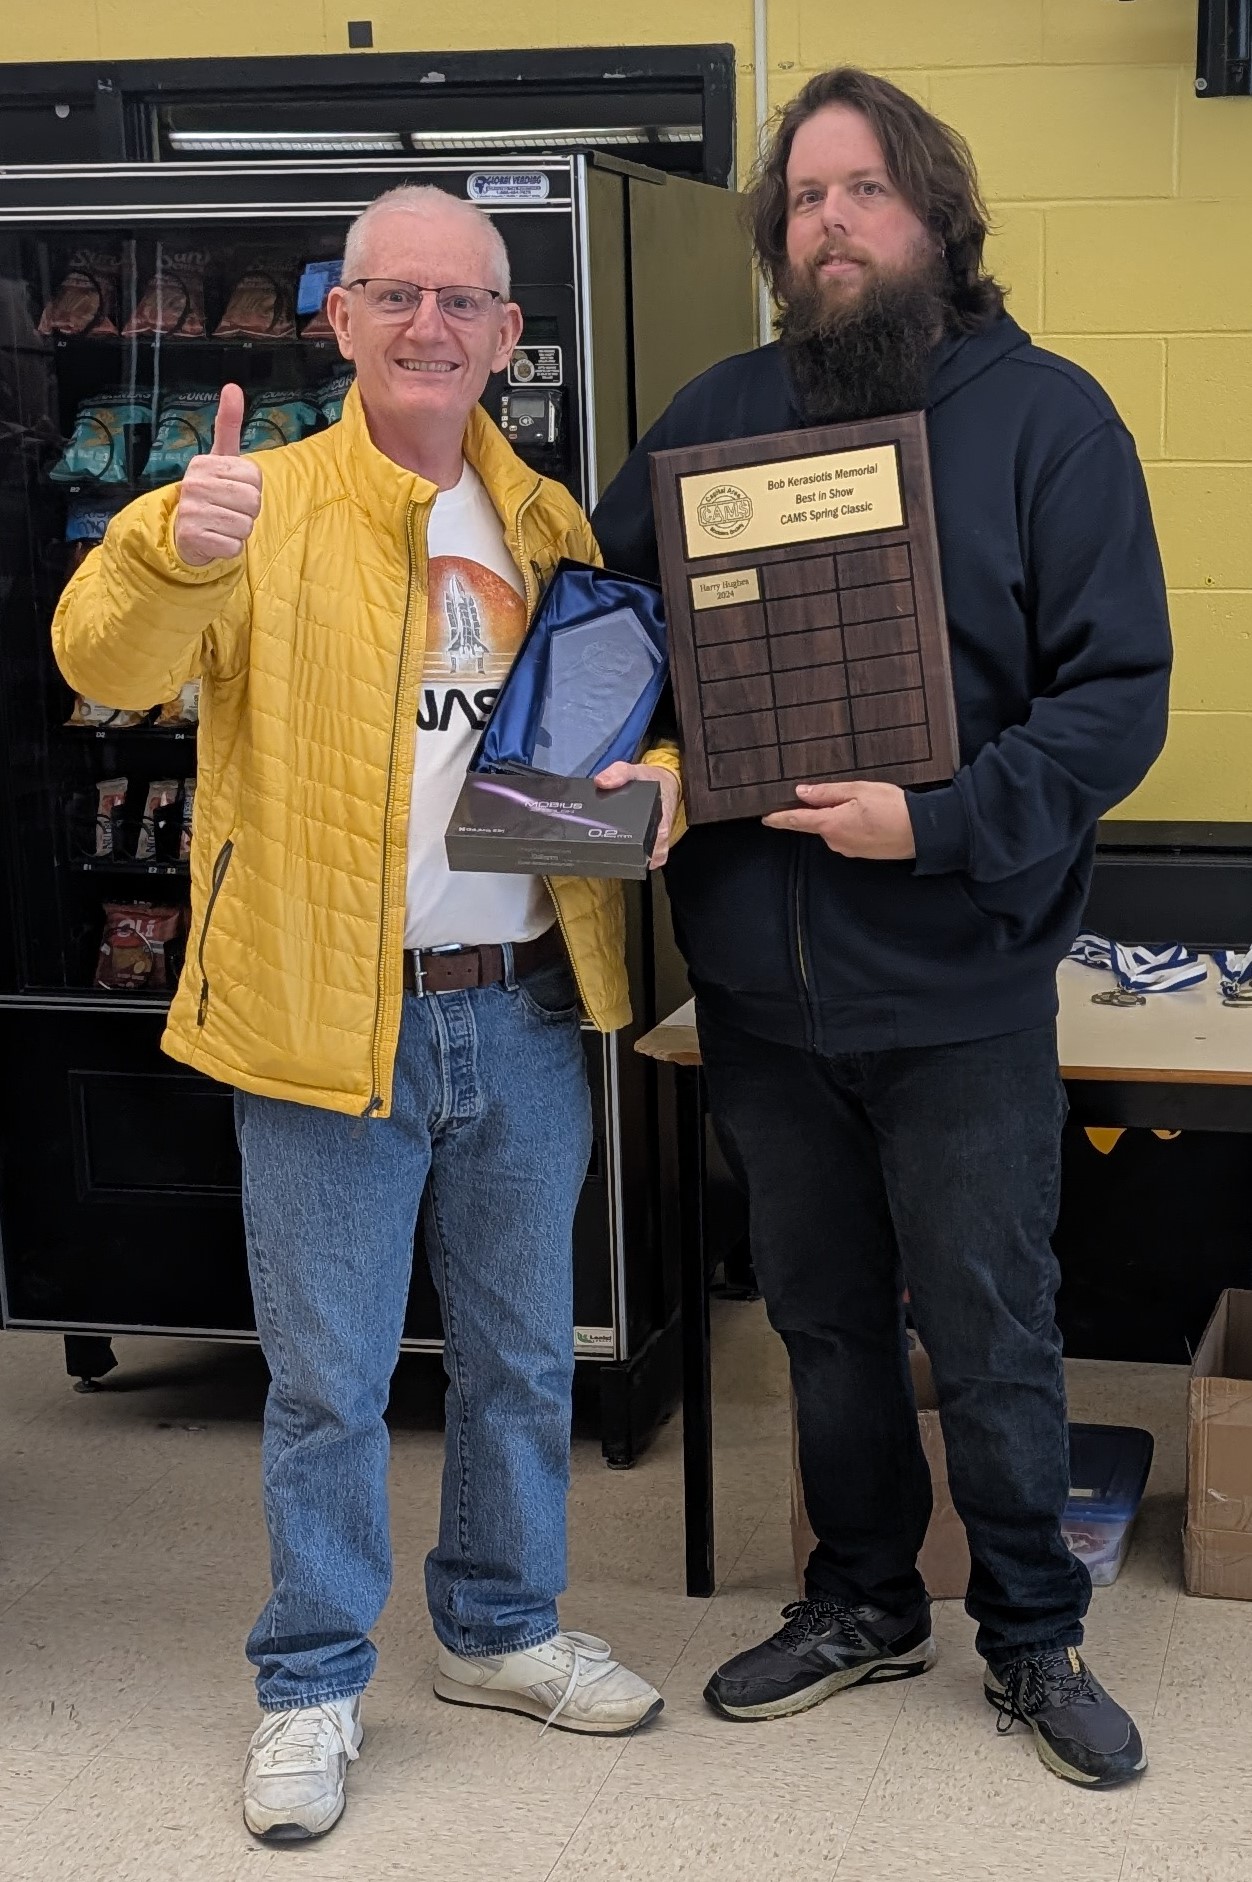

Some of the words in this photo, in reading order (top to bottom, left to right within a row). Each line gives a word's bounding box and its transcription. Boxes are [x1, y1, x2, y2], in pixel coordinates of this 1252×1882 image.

[767, 475, 786, 491] Bob
[787, 471, 833, 488] Kerasiotis
[834, 462, 878, 480] Memorial
[795, 493, 817, 505] Best
[818, 490, 827, 500] in
[828, 486, 855, 499] Show
[702, 499, 750, 524] CAMS
[780, 512, 808, 525] CAMS
[809, 506, 839, 520] Spring
[840, 501, 874, 515] Classic
[699, 583, 721, 592] Harry
[722, 579, 750, 589] Hughes
[716, 590, 735, 600] 2024
[416, 688, 501, 731] NAS
